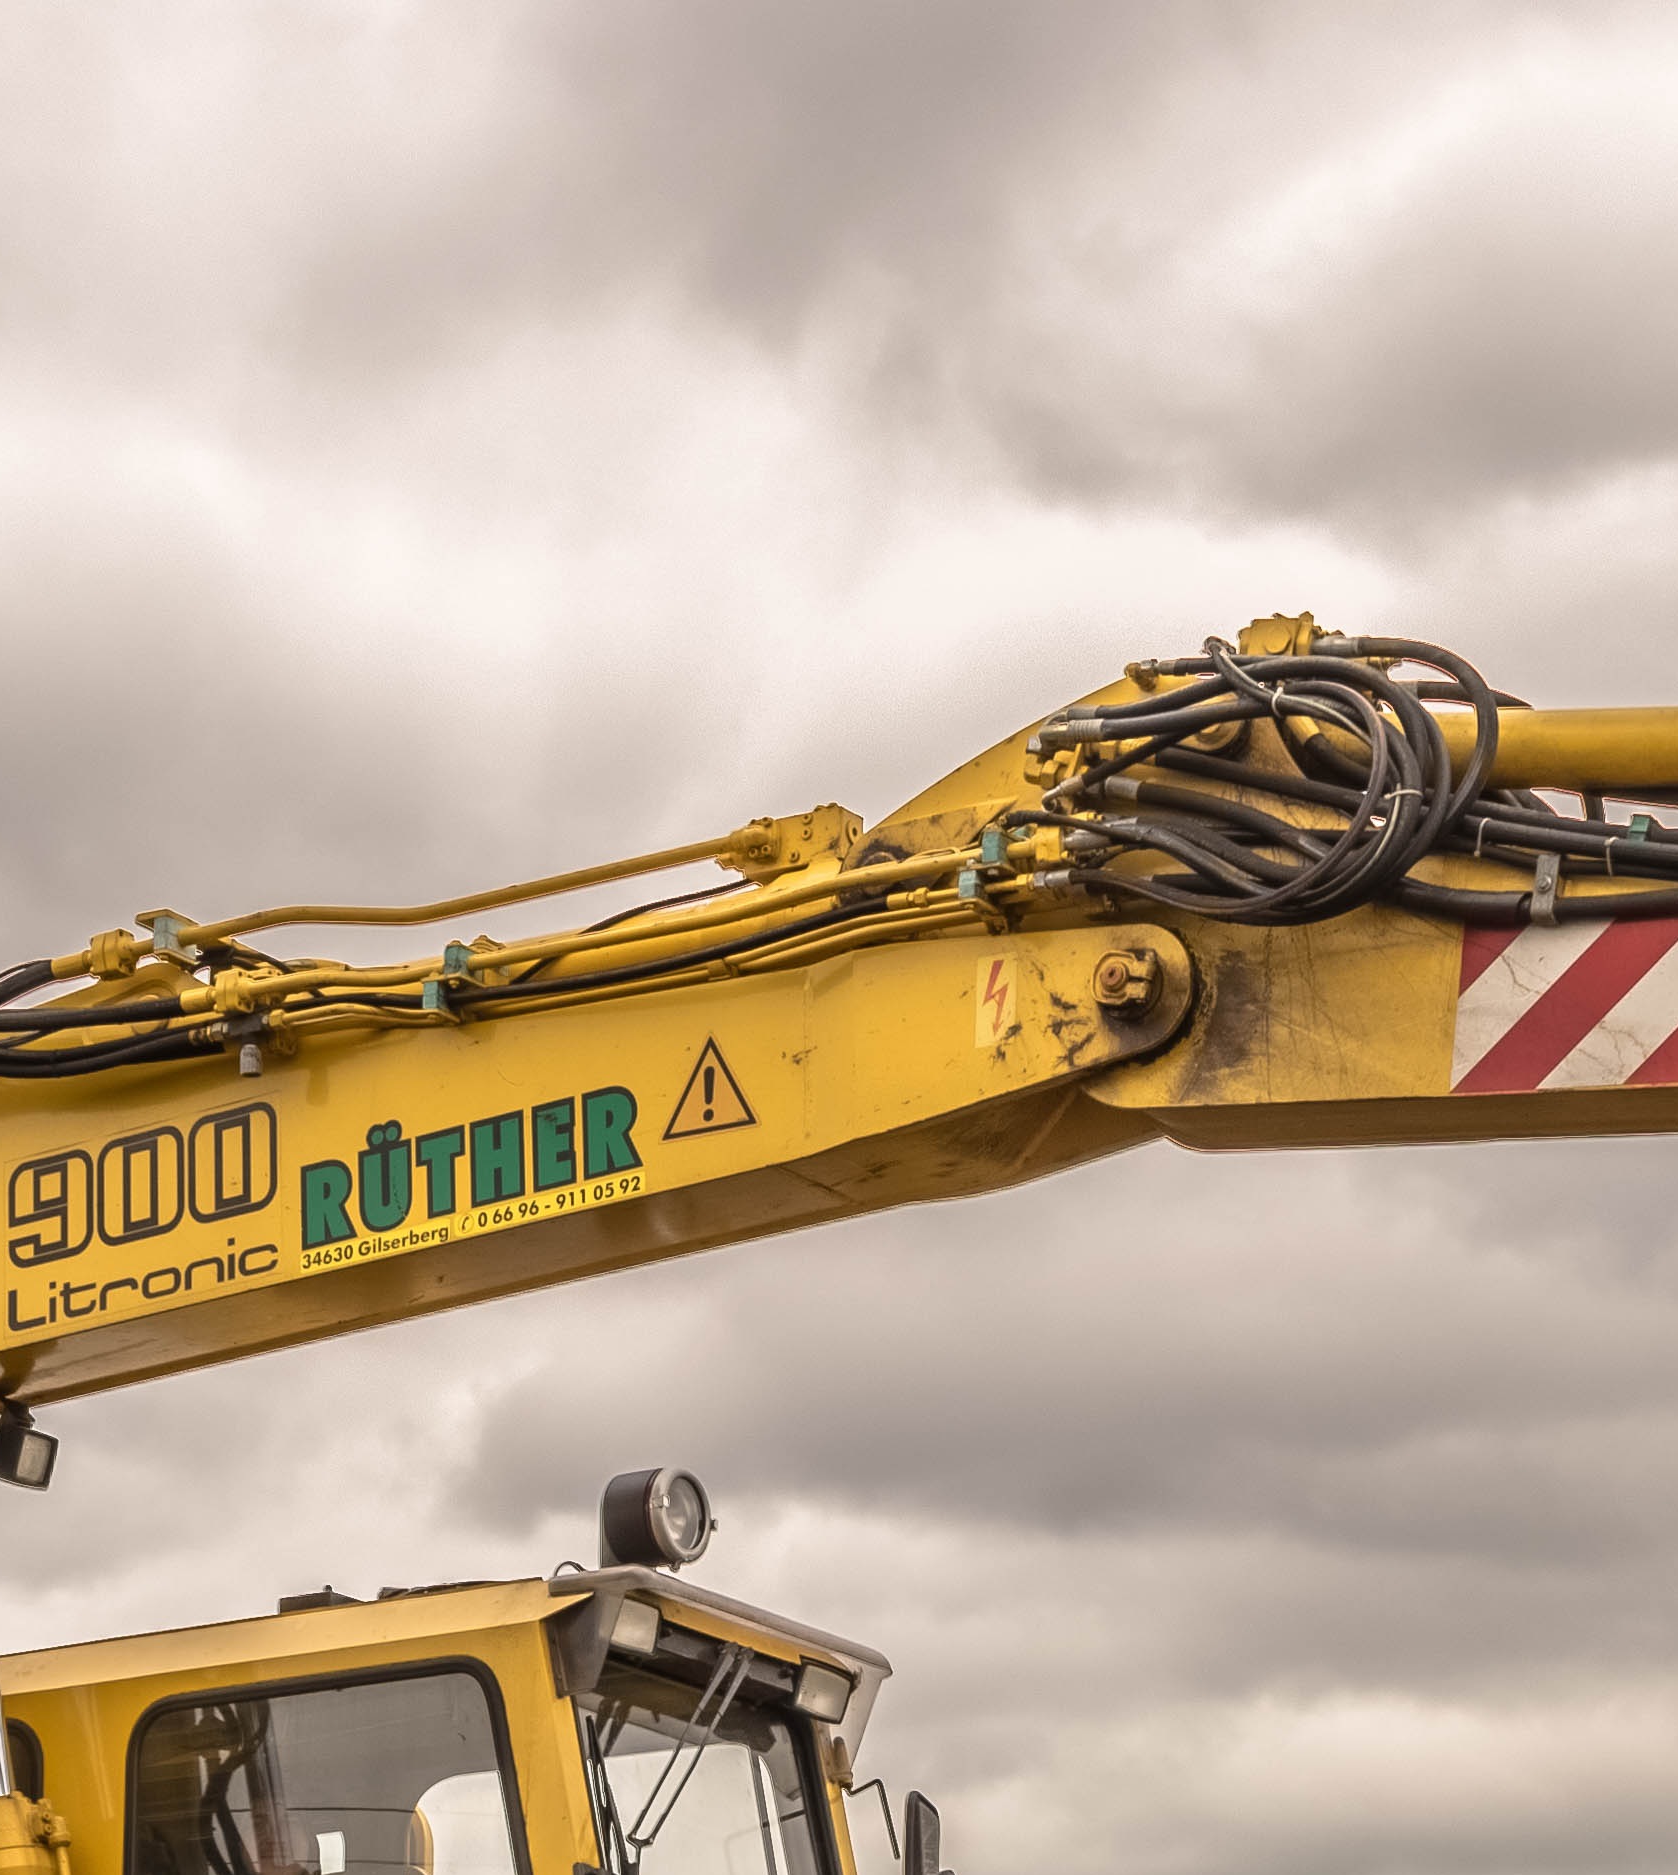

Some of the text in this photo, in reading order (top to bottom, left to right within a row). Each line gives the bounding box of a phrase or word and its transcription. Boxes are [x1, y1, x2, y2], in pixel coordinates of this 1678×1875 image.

[8, 1101, 278, 1269] 900
[300, 1085, 644, 1251] RÜTHER
[301, 1244, 355, 1270] 34630
[357, 1224, 450, 1258] Gilserberg
[478, 1211, 489, 1228] 0
[493, 1206, 514, 1225] 66
[518, 1201, 540, 1220] 96
[556, 1188, 588, 1210] 911
[593, 1182, 615, 1202] 05
[620, 1175, 642, 1195] 92
[7, 1237, 279, 1332] Litronic
